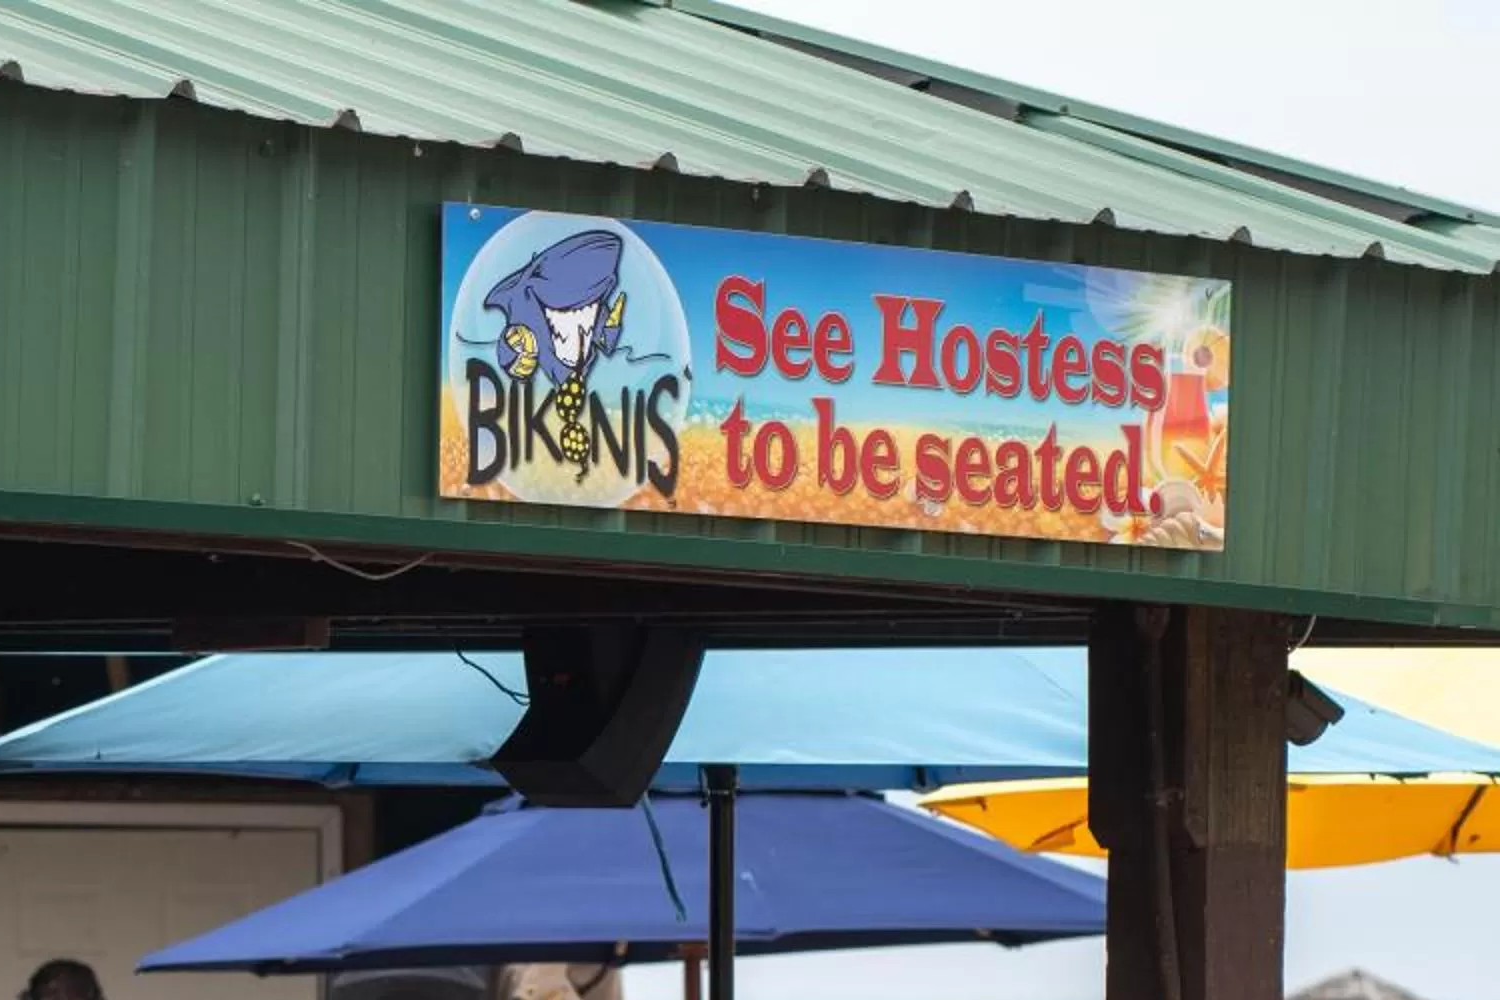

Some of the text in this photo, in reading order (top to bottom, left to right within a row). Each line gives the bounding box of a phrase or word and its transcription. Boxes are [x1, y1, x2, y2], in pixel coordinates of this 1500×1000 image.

[714, 274, 1164, 412] See Hostess
[720, 396, 1163, 515] to be seated.
